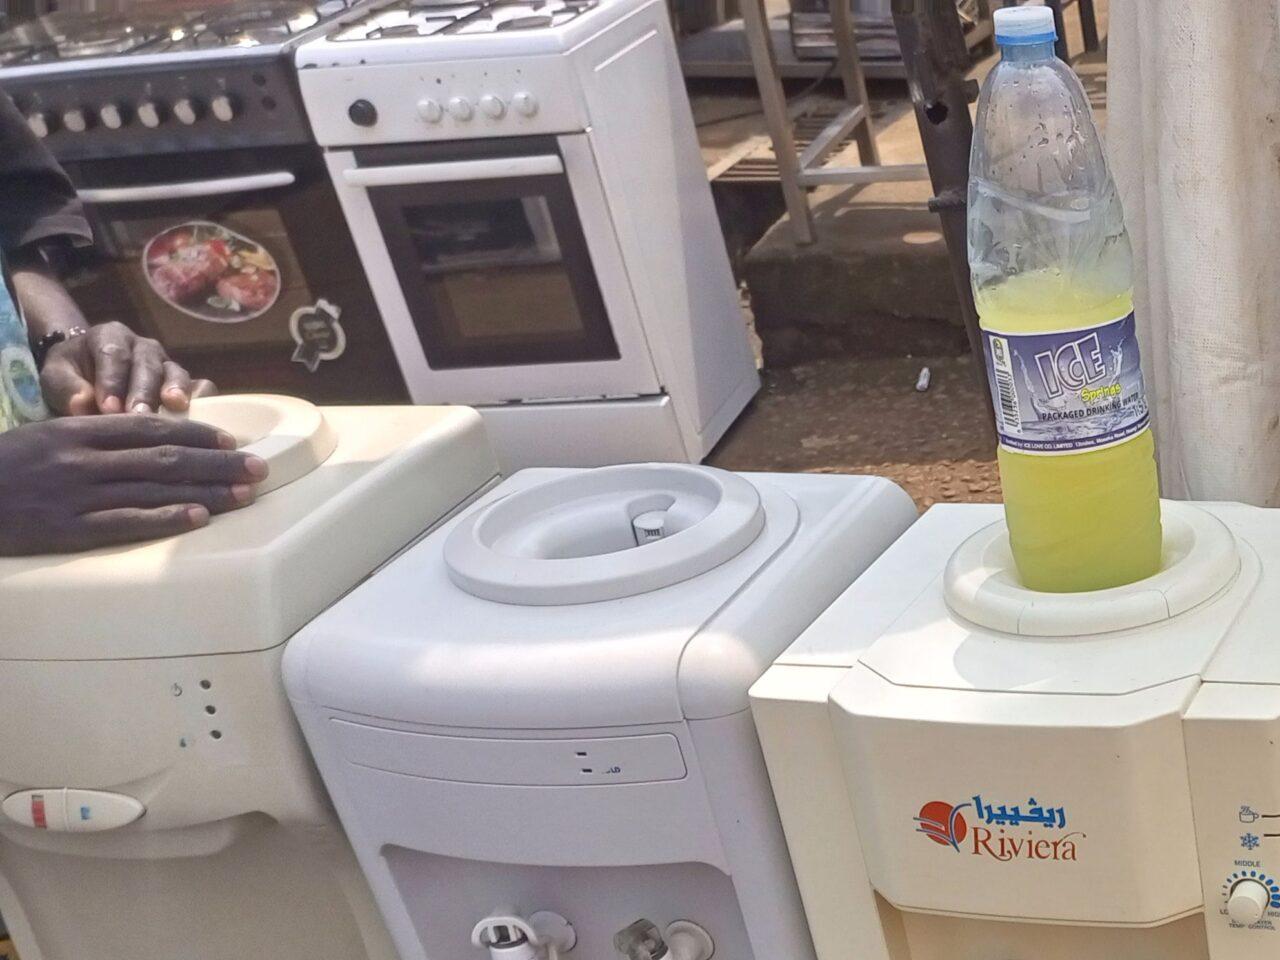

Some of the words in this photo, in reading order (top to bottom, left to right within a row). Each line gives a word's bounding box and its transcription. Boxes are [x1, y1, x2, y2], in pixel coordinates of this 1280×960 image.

[1034, 332, 1107, 399] ICE
[1042, 409, 1085, 420] PACKAGED
[1086, 399, 1122, 416] DRINKING
[971, 826, 1087, 861] Riviera
[1234, 860, 1261, 868] MIDDLE
